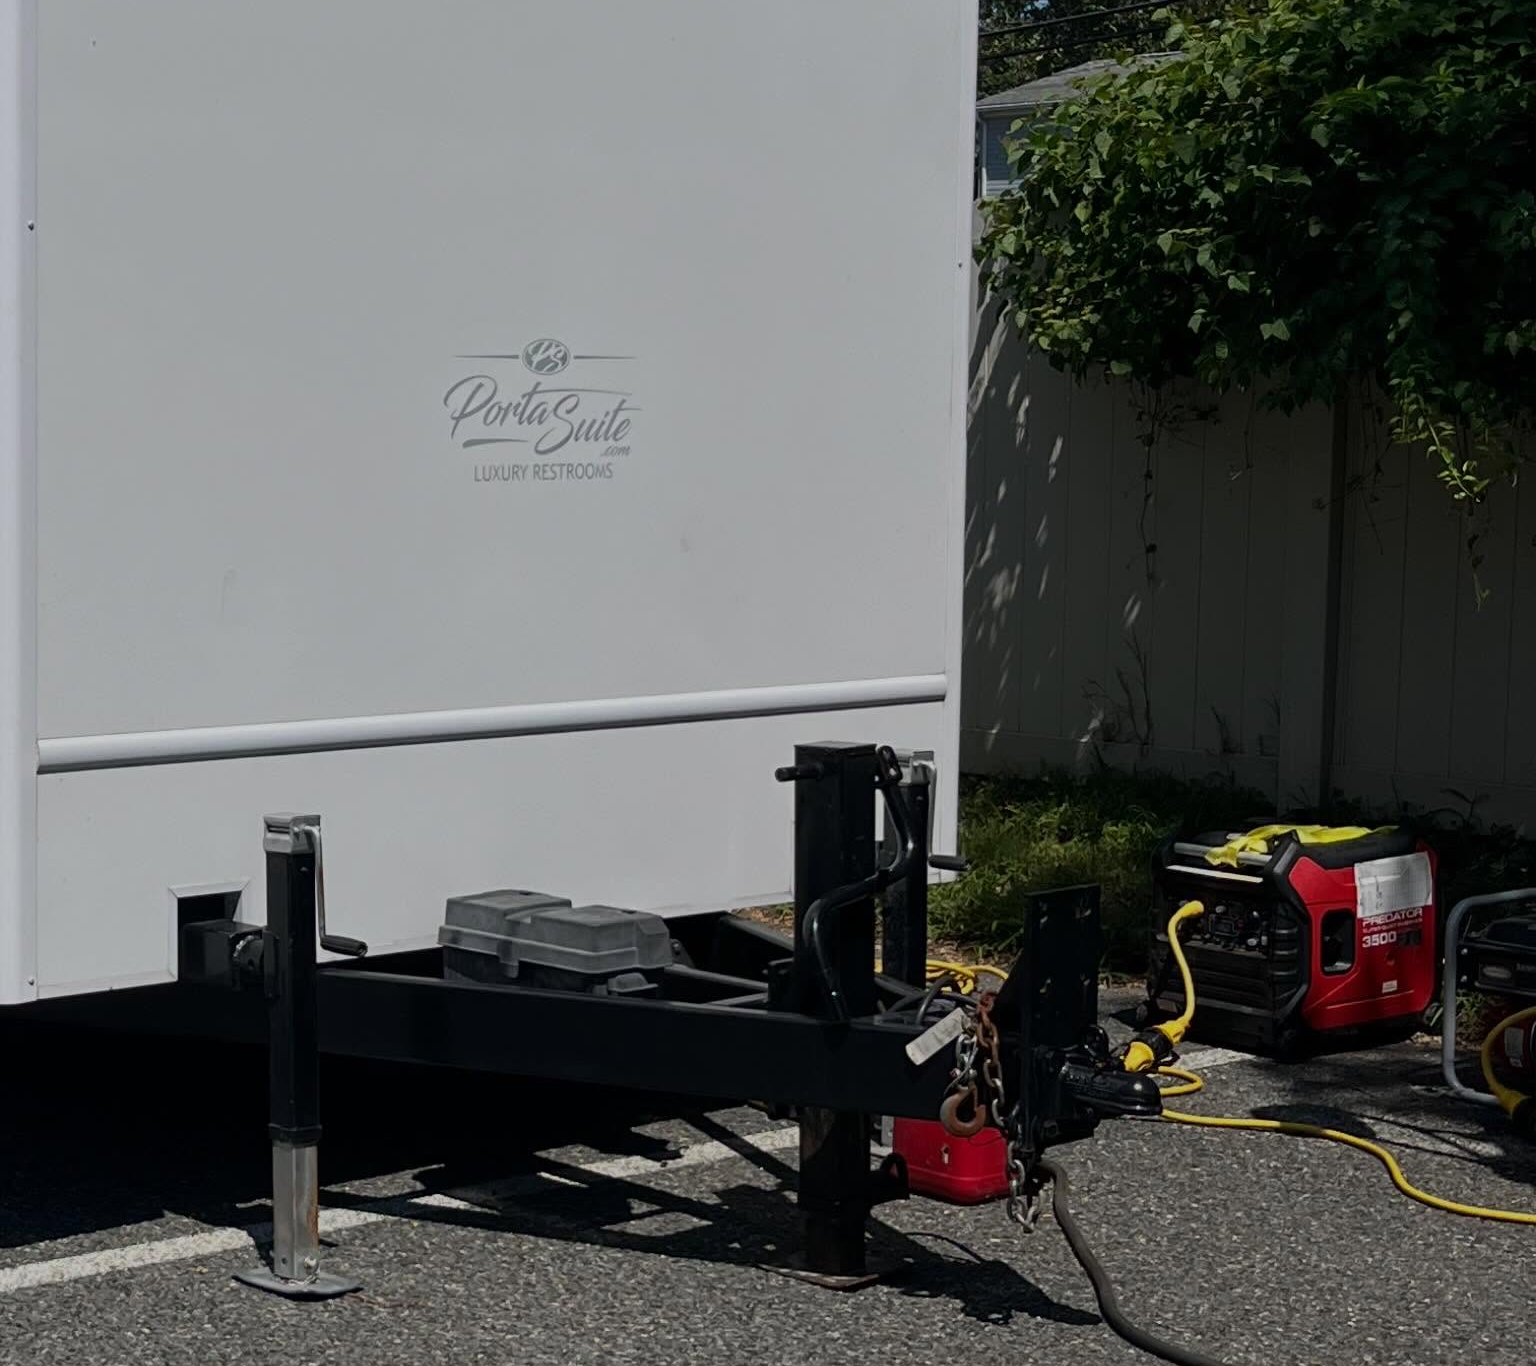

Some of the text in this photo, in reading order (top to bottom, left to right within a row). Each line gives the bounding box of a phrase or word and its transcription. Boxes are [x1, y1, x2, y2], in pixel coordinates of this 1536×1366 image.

[473, 462, 614, 482] LUXURY RESTROOMS
[1362, 907, 1423, 927] PREDATOR
[1362, 931, 1397, 947] 3500
